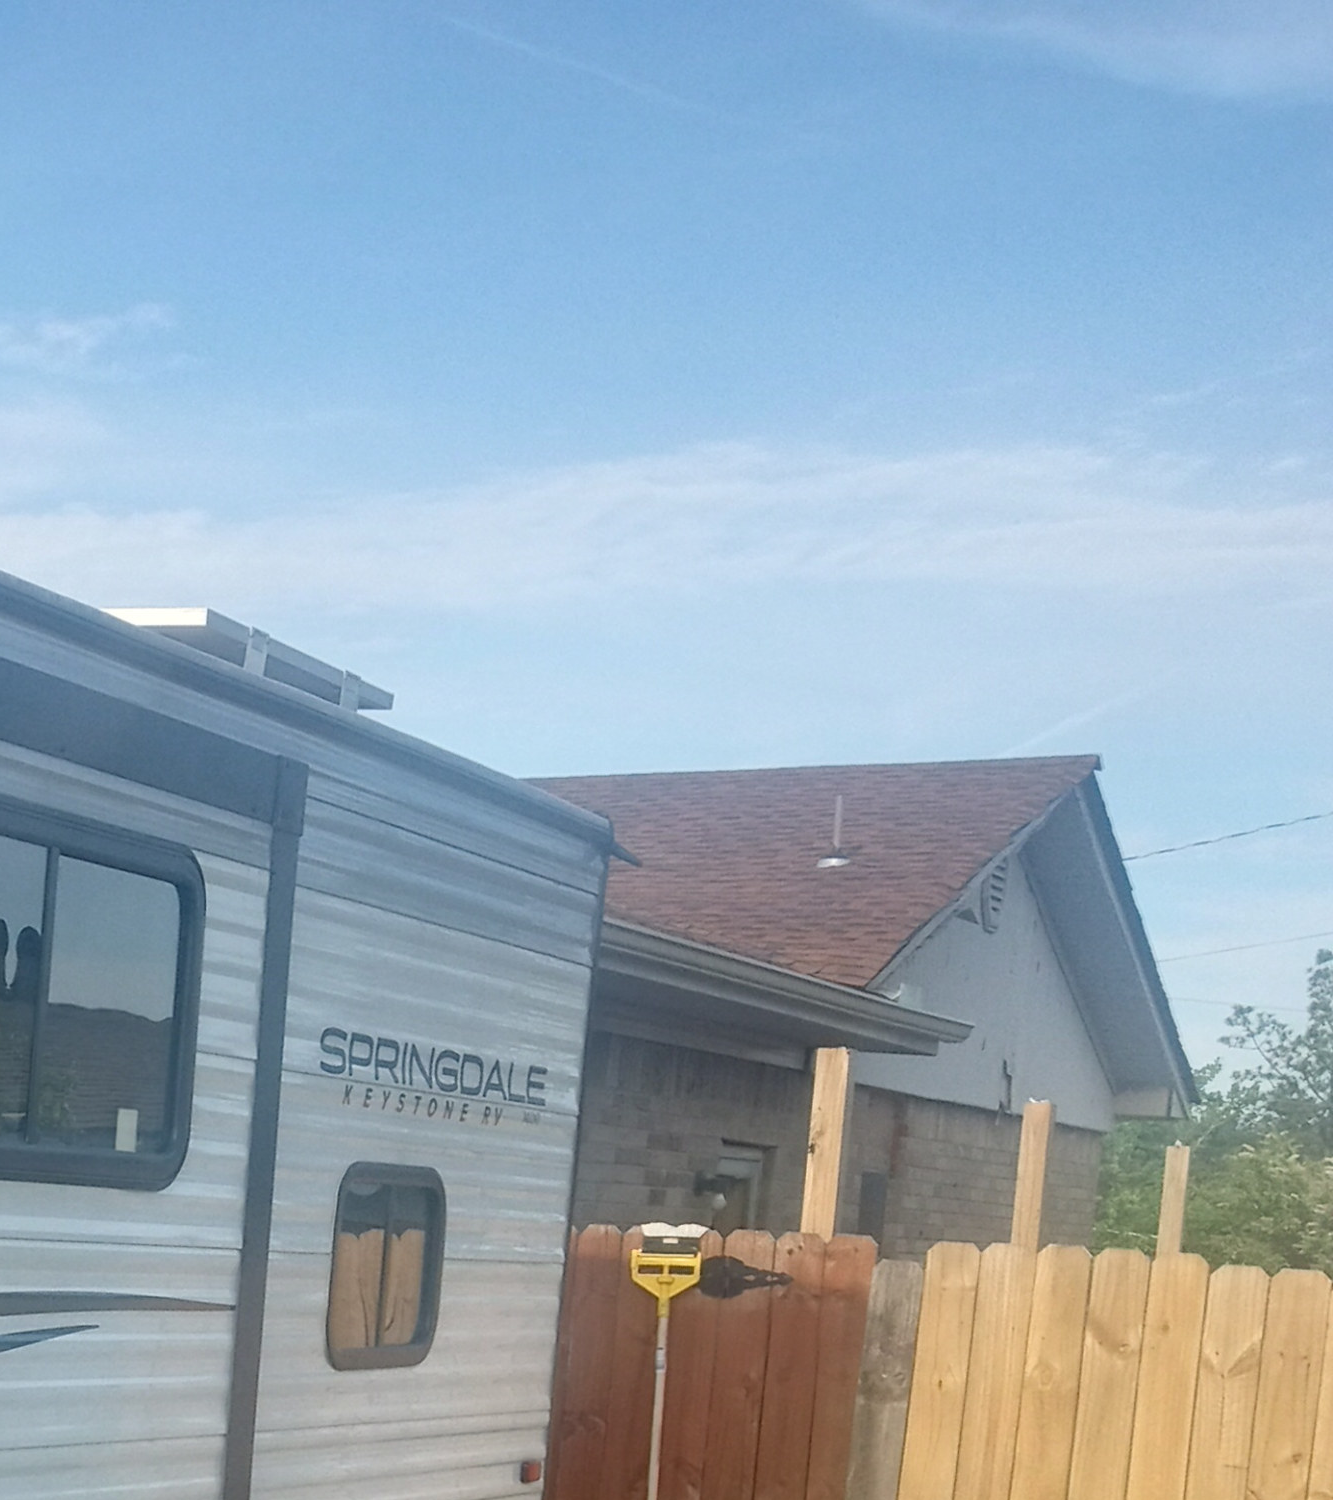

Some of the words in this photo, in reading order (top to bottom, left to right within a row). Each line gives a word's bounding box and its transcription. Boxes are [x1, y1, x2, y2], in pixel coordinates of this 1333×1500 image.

[319, 1026, 548, 1107] SPRINGDALE
[342, 1084, 469, 1122] KEYSTONE
[482, 1105, 503, 1126] RV
